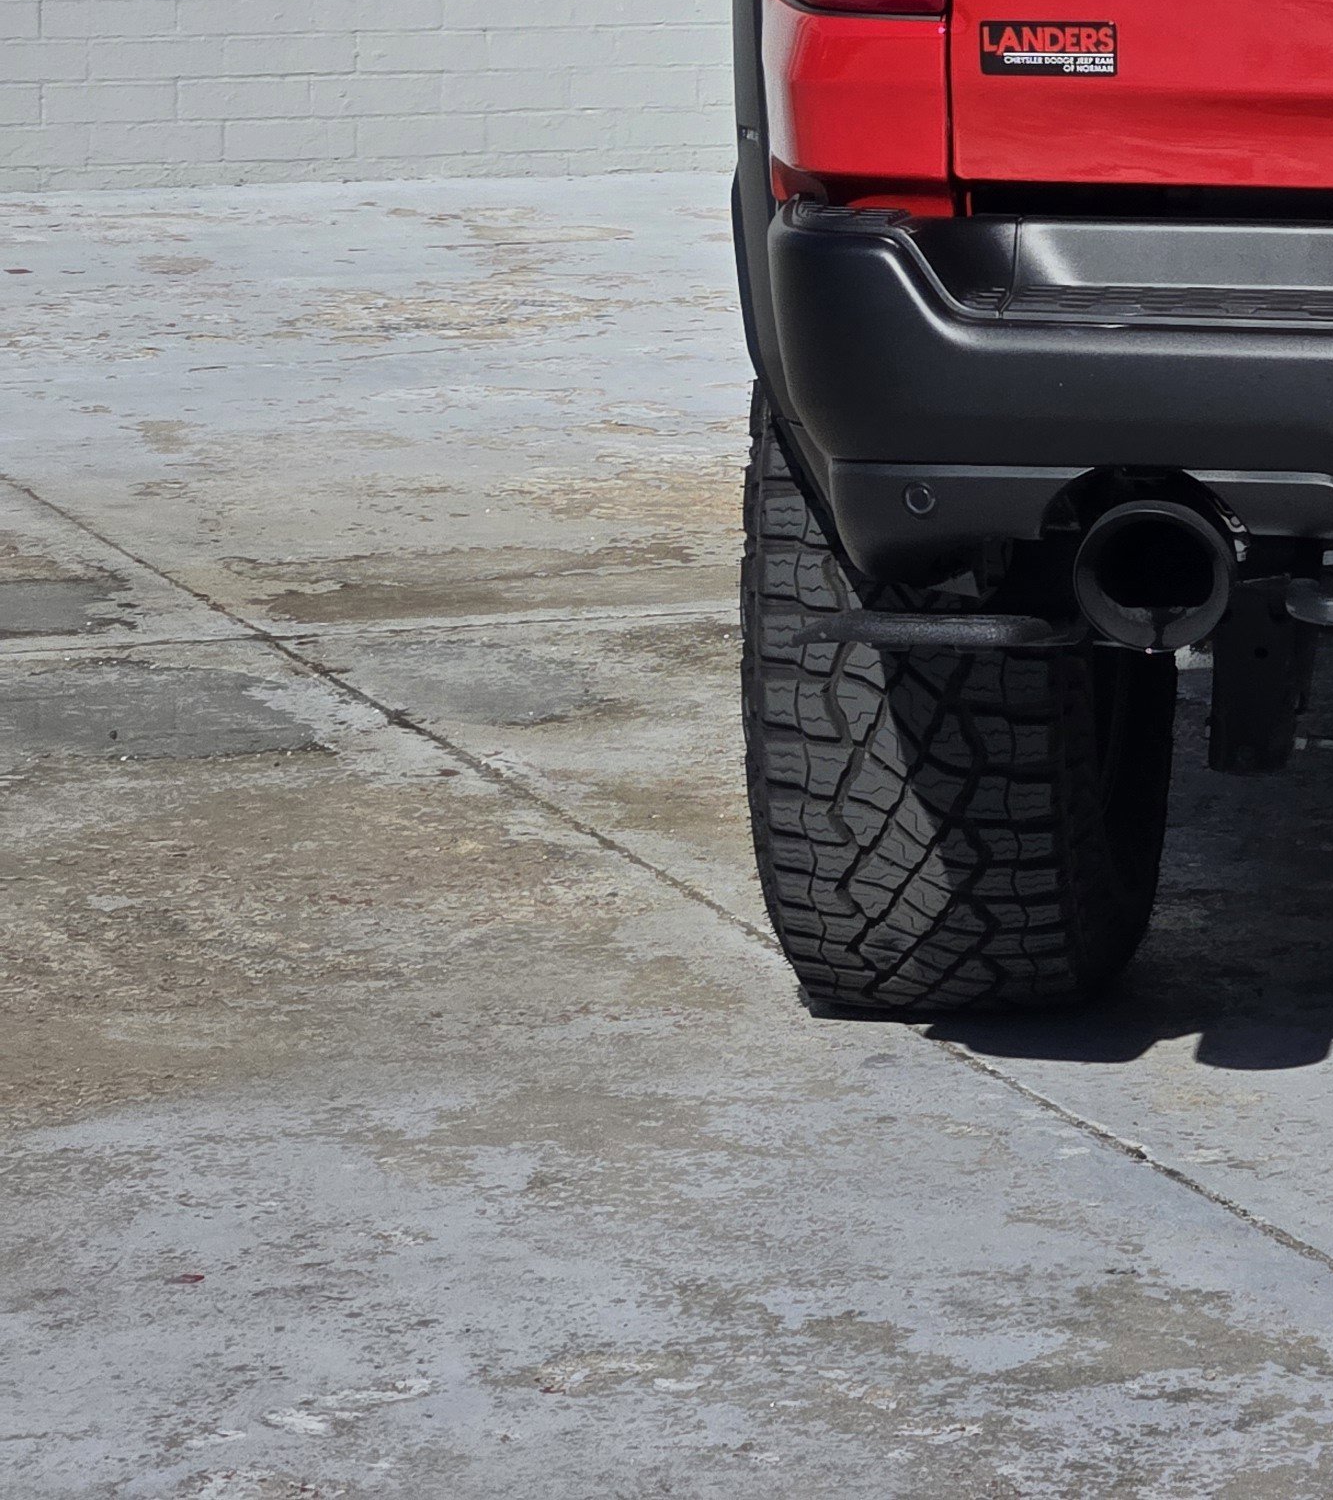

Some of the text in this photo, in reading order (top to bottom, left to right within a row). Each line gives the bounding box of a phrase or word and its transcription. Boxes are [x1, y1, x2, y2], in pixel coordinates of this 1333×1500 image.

[982, 26, 1114, 55] LANDERS
[1003, 56, 1114, 65] CHRYSLER DODGE JEEP RAM
[1063, 64, 1114, 73] OF NORMAN
